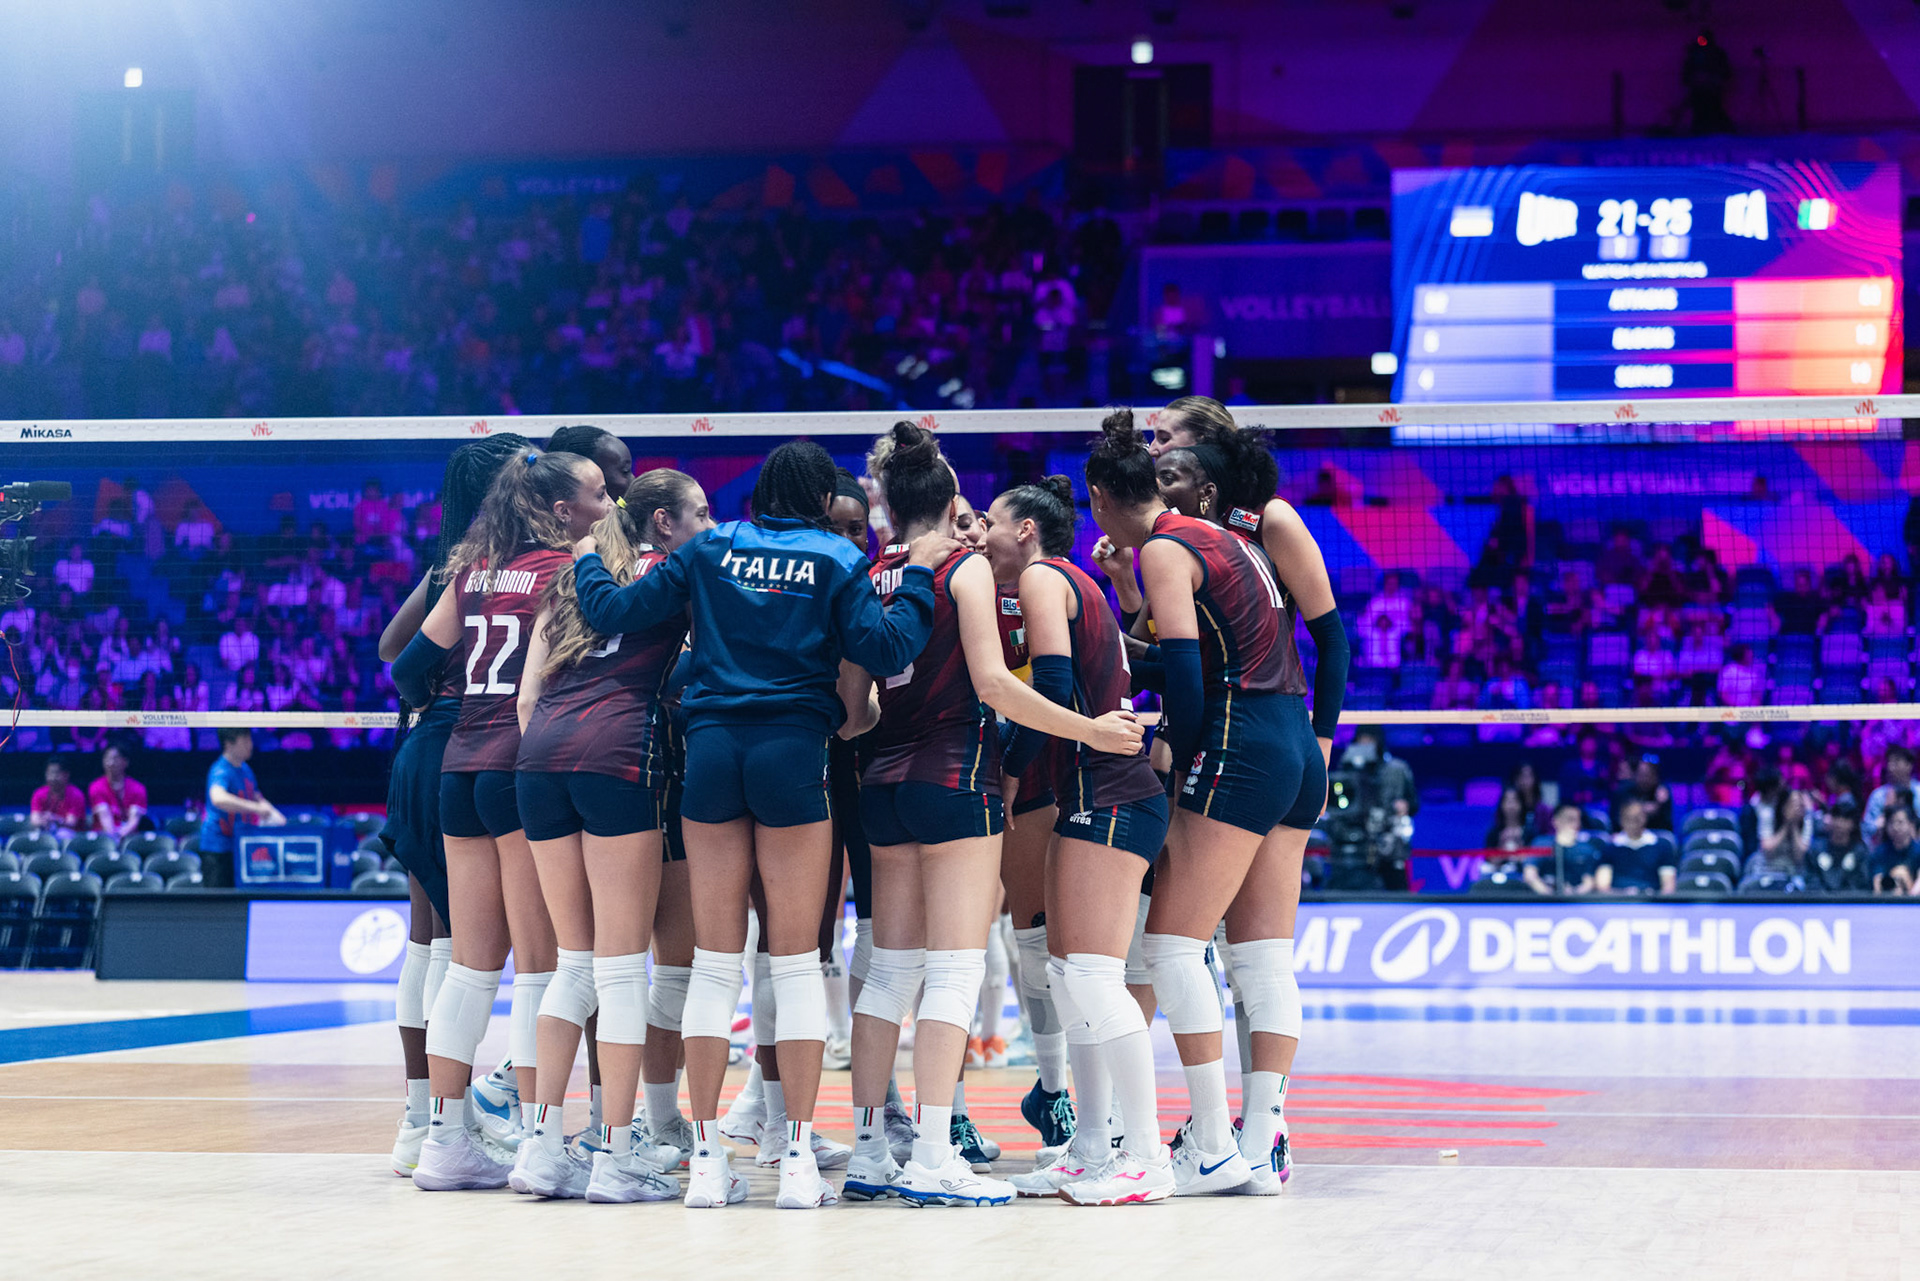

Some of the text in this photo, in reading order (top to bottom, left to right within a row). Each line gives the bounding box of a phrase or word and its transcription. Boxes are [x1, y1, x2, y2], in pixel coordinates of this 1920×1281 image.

[720, 549, 815, 585] ITALIA
[464, 615, 520, 695] 22
[1468, 918, 1851, 974] DECATHLON
